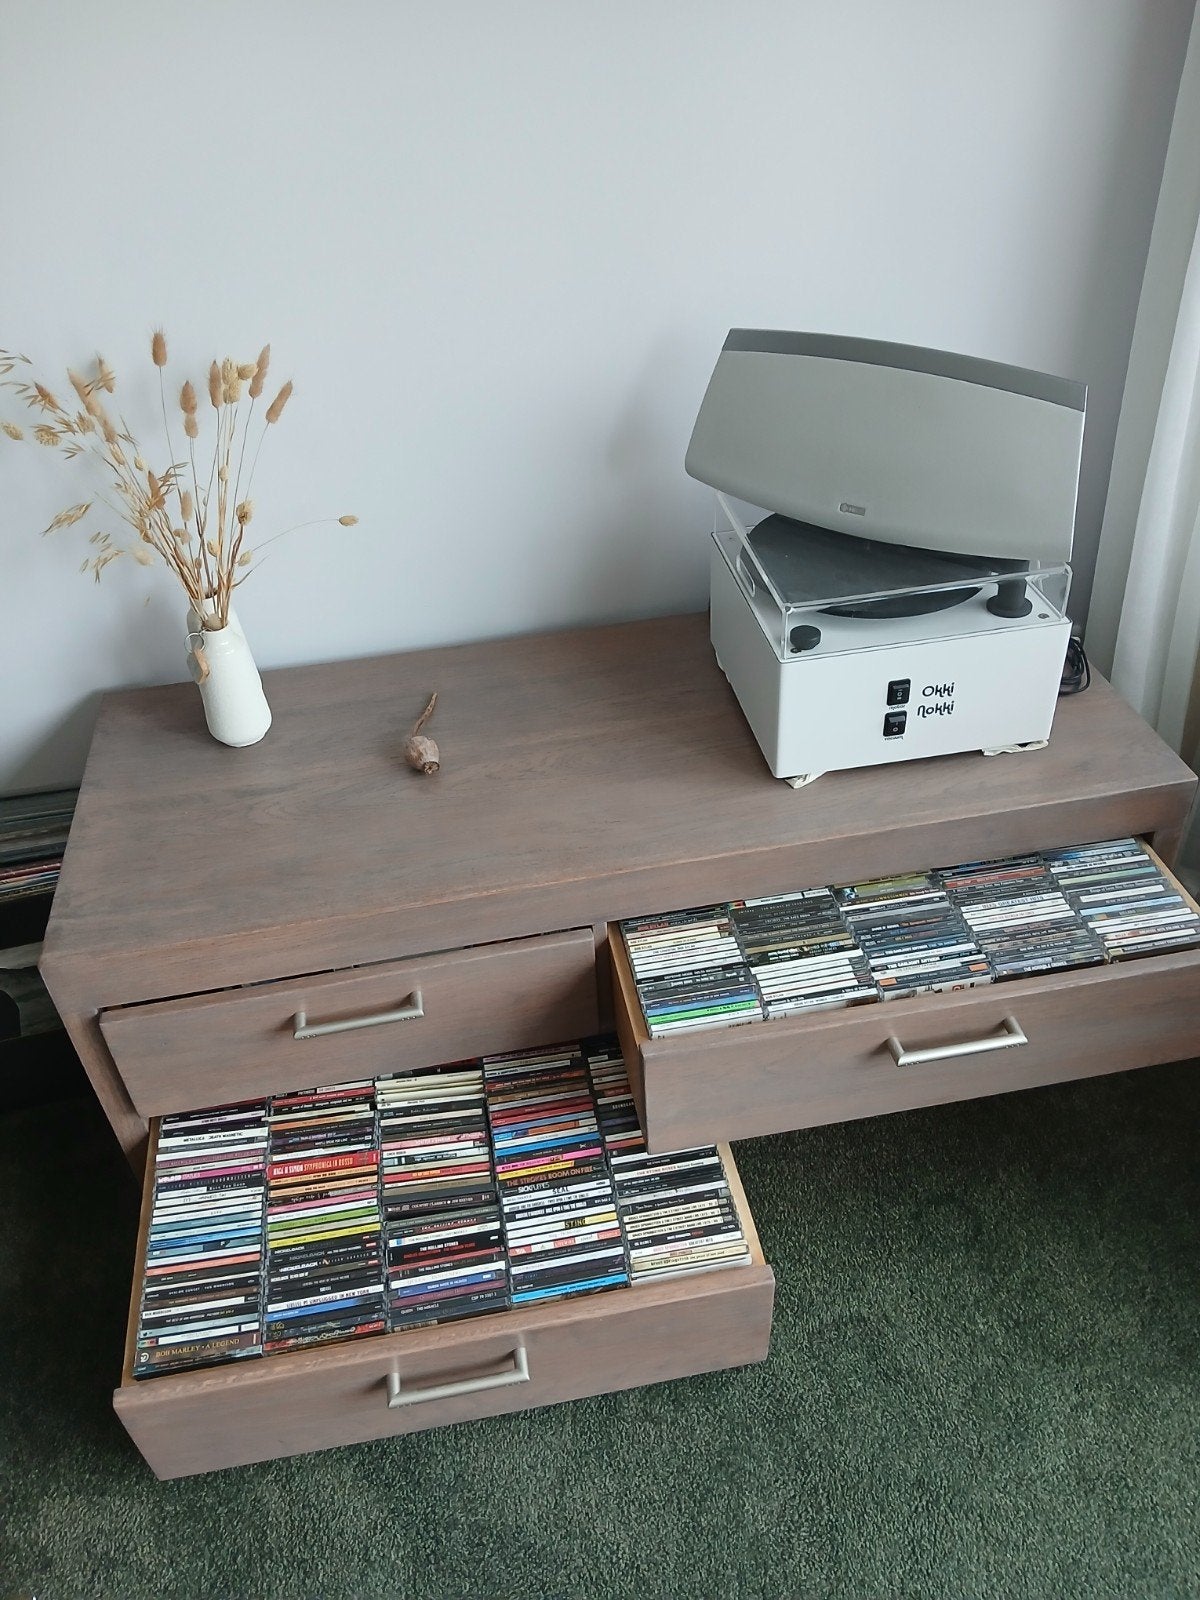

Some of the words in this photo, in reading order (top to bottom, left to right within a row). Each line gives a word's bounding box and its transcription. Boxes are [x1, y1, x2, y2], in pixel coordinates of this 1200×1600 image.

[922, 682, 955, 698] Okki
[520, 1173, 547, 1185] STROKES
[548, 1171, 570, 1180] ROOM
[552, 1186, 570, 1195] SEAL
[156, 1350, 170, 1358] BOB
[172, 1344, 200, 1356] MARLEY
[212, 1338, 240, 1348] LEGEND
